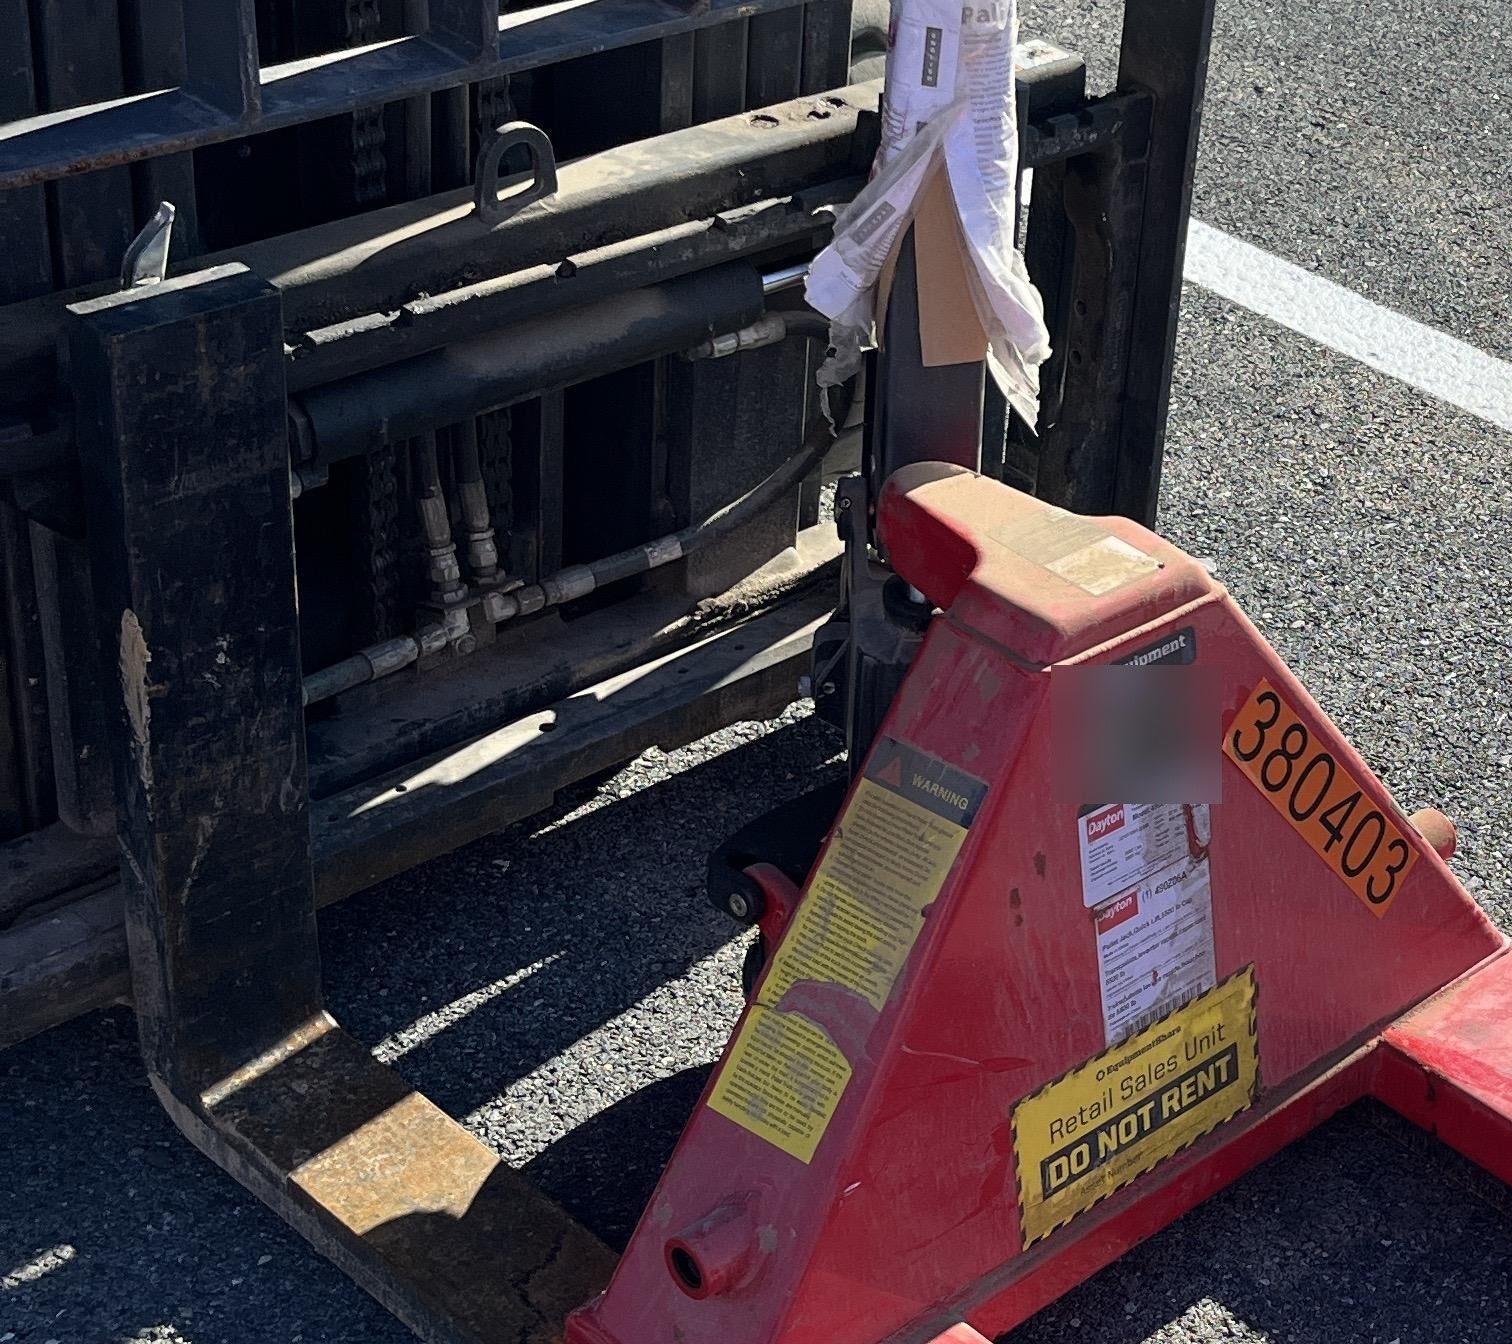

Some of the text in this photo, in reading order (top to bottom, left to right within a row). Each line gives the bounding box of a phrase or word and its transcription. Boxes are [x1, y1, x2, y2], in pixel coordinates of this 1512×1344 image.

[911, 773, 969, 810] WARNING
[1087, 808, 1123, 836] Dayton
[1232, 691, 1409, 904] 380403
[1049, 1054, 1232, 1189] DO NOT RENT
[1050, 1023, 1226, 1145] Retail Sales Unit
